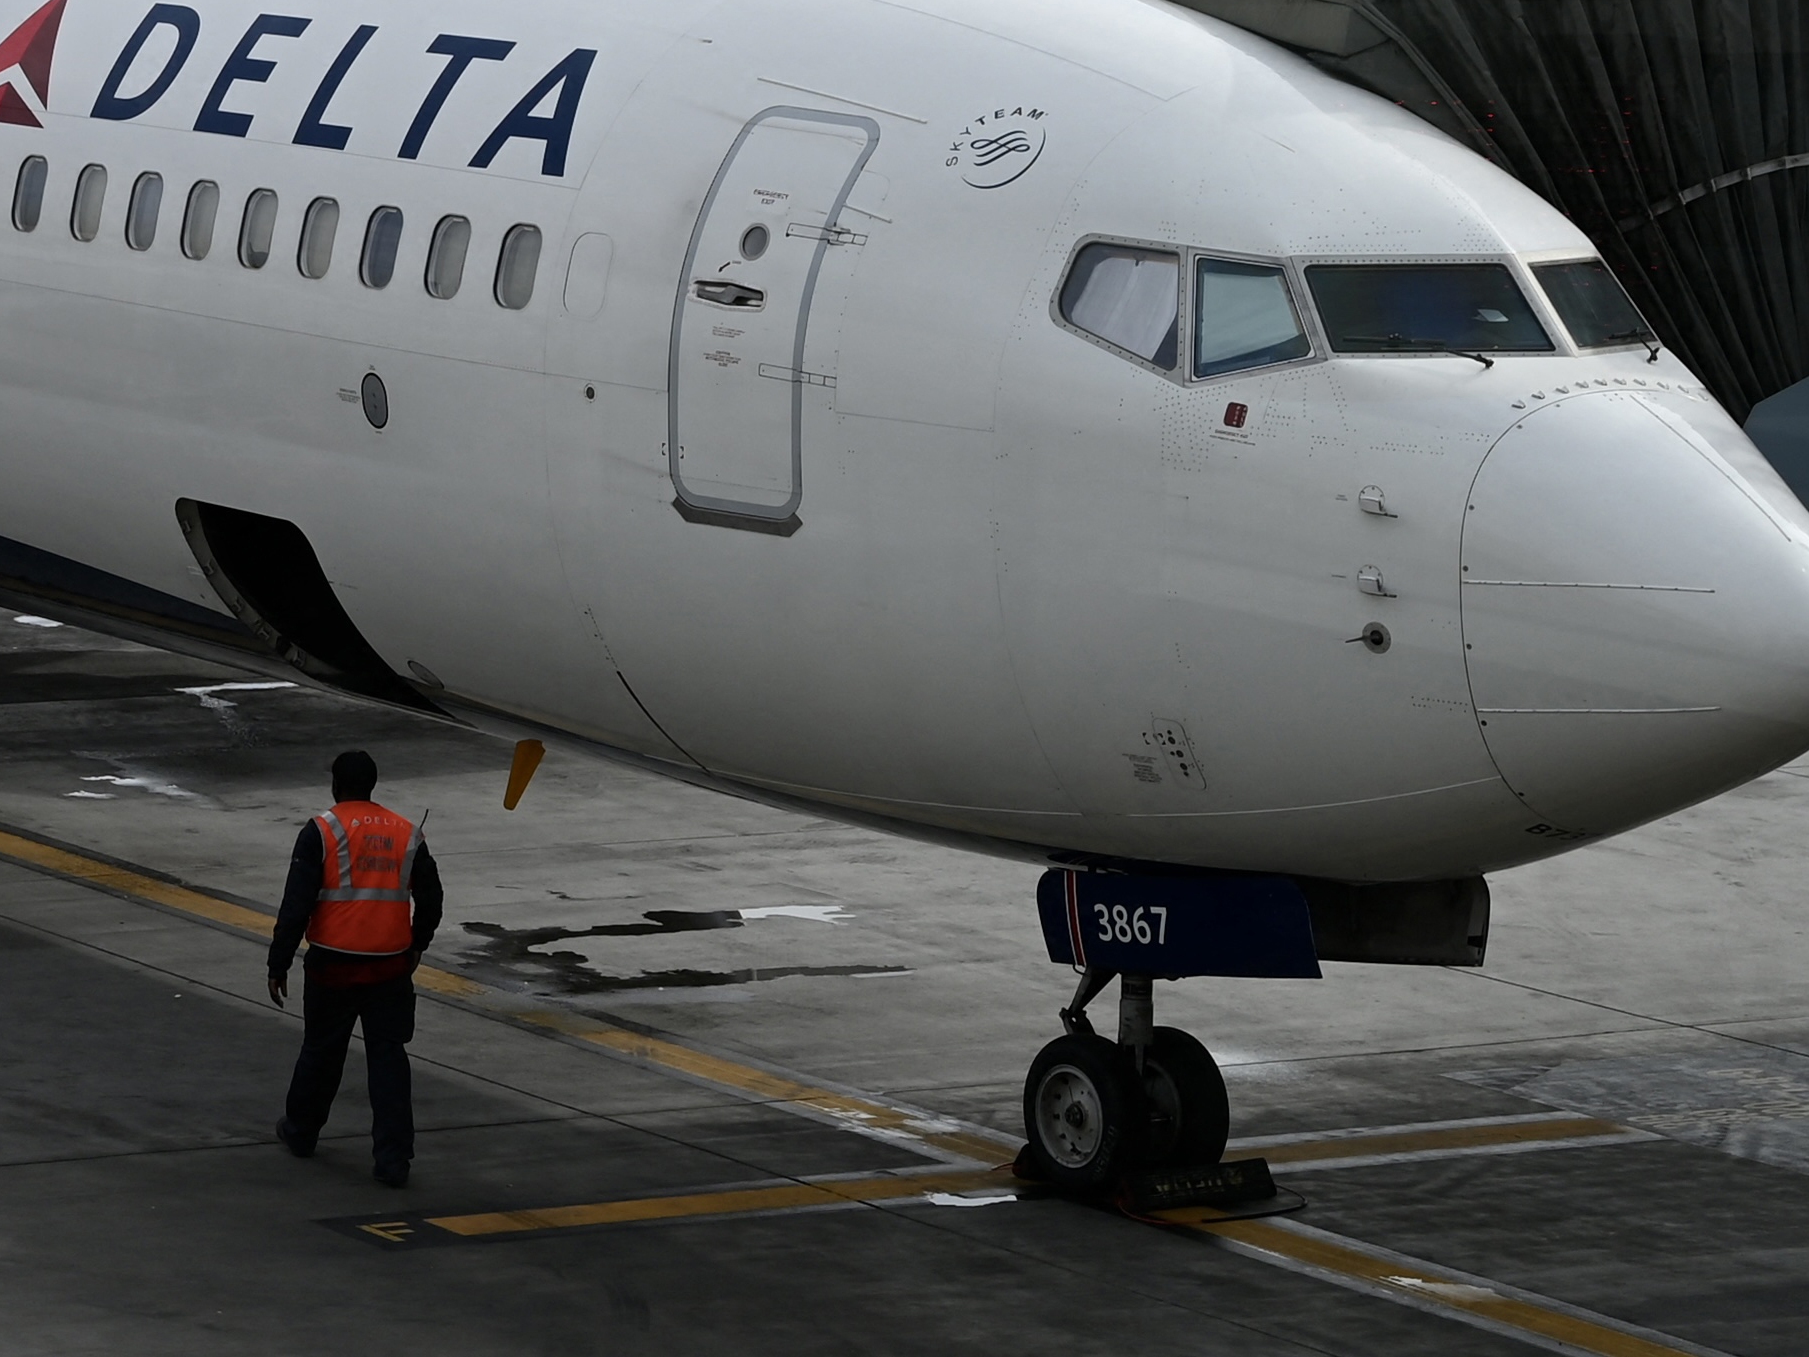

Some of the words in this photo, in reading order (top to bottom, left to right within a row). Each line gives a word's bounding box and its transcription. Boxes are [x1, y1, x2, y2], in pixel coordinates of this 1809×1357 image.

[90, 2, 599, 177] DELTA
[945, 107, 1045, 167] SKYTEAM
[1093, 903, 1167, 945] 3867
